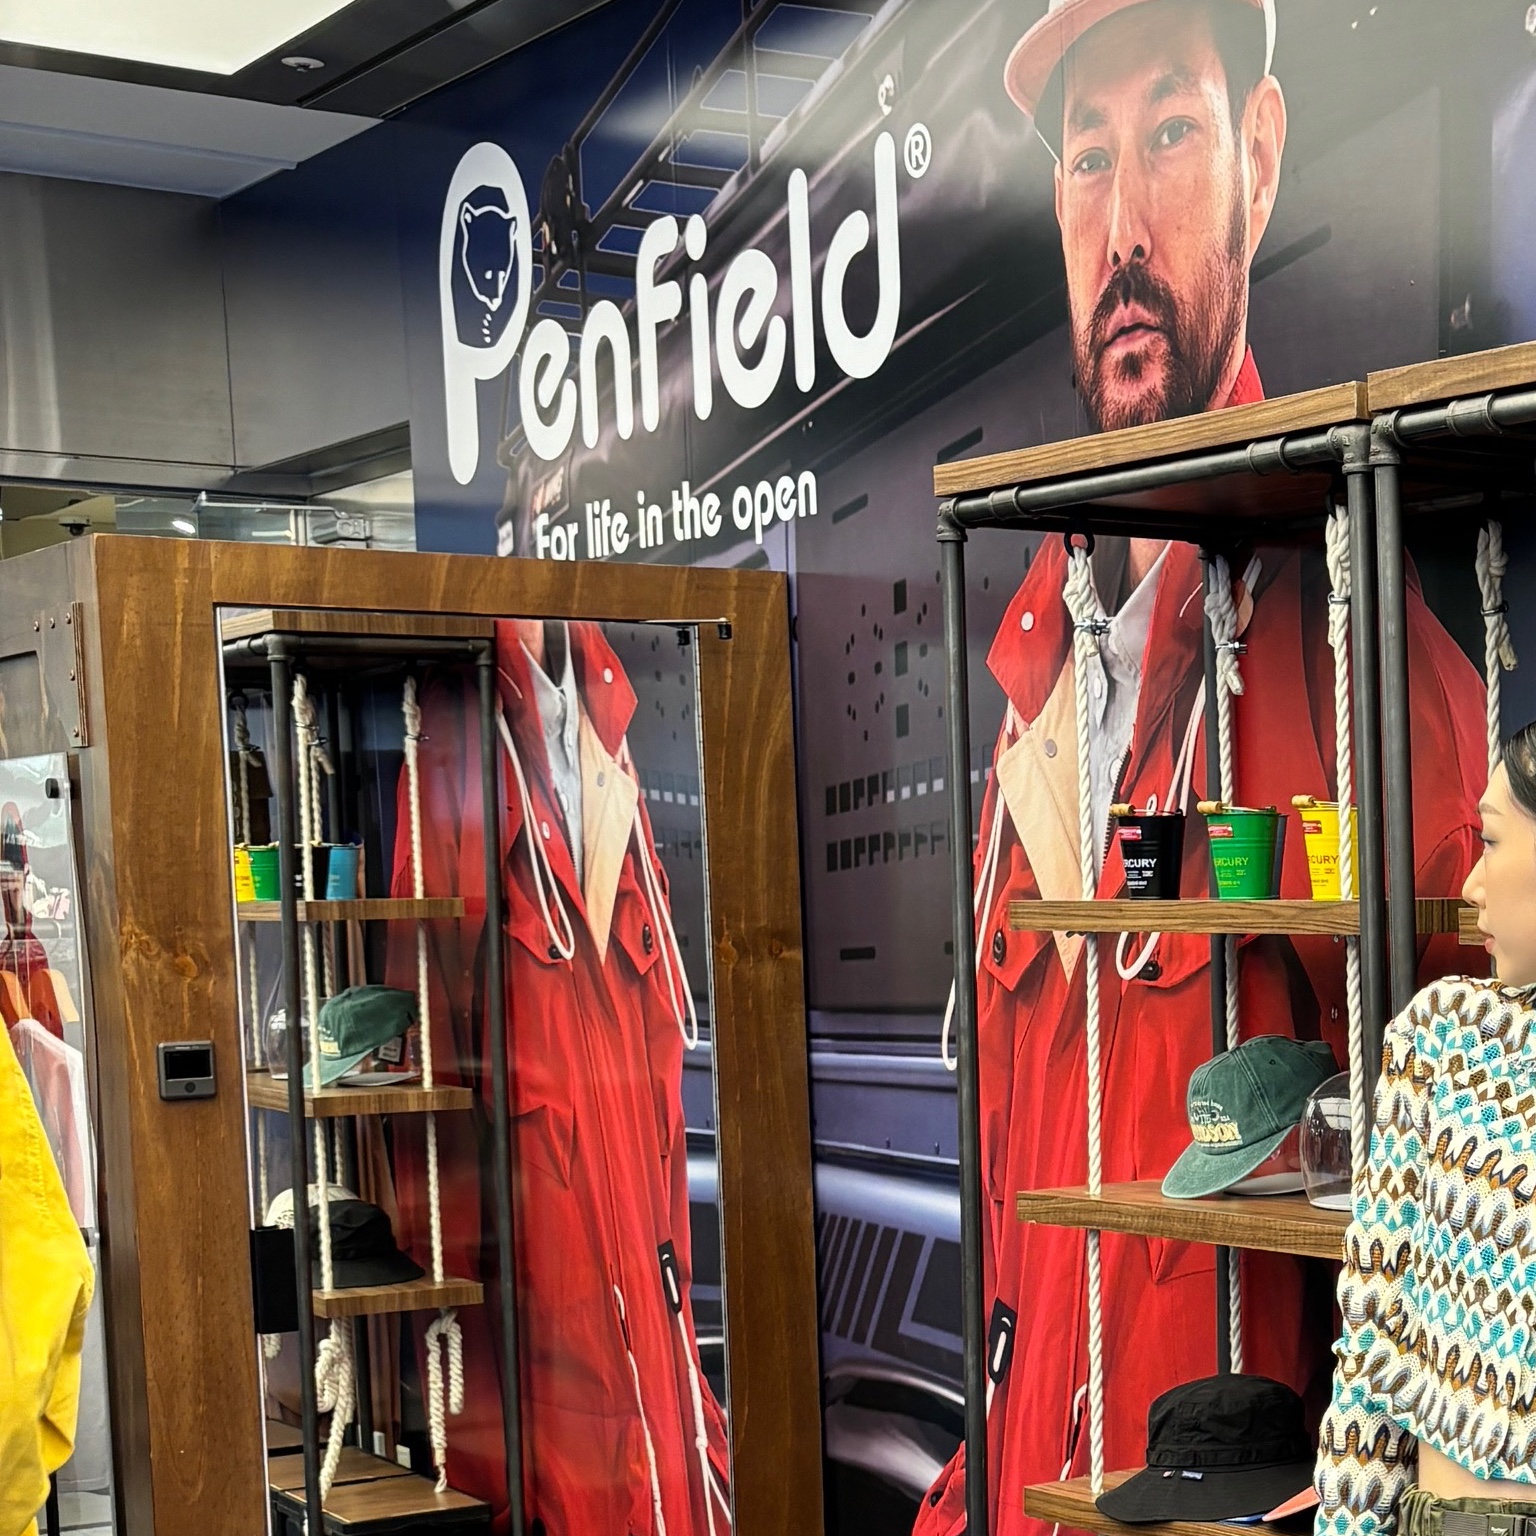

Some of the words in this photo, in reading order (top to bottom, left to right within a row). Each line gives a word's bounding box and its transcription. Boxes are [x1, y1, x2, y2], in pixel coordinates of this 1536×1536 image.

[536, 512, 578, 561] For
[586, 499, 630, 559] life
[638, 490, 664, 549] in
[672, 480, 722, 541] the
[732, 470, 818, 545] open
